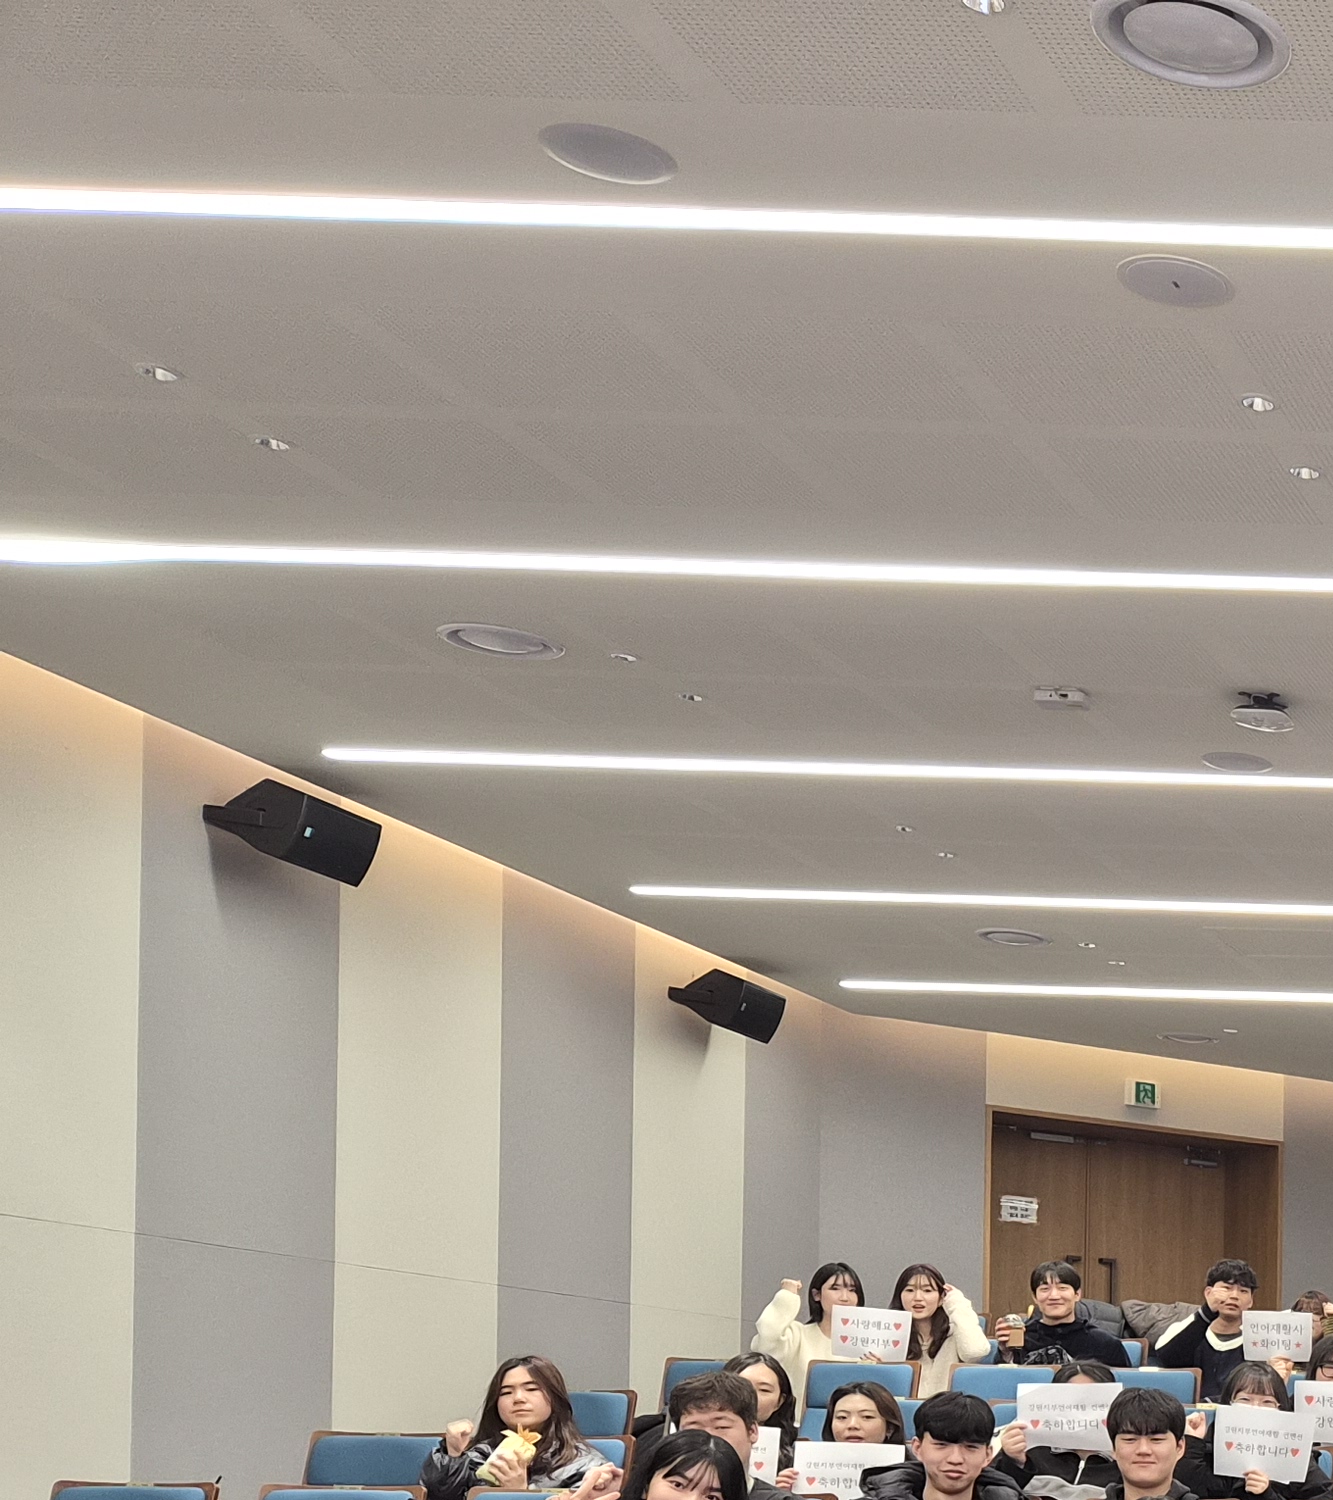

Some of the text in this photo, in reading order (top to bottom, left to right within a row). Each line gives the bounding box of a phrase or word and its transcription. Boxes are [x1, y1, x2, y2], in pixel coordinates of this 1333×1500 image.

[850, 1317, 893, 1332] 사랑해요
[1249, 1323, 1304, 1335] 언어재활사
[849, 1334, 891, 1349] 강원지부
[1260, 1338, 1292, 1351] 화이팅
[1042, 1417, 1100, 1431] 축하합니다
[1235, 1441, 1290, 1458] 축하합니다
[818, 1476, 859, 1489] 축하합
